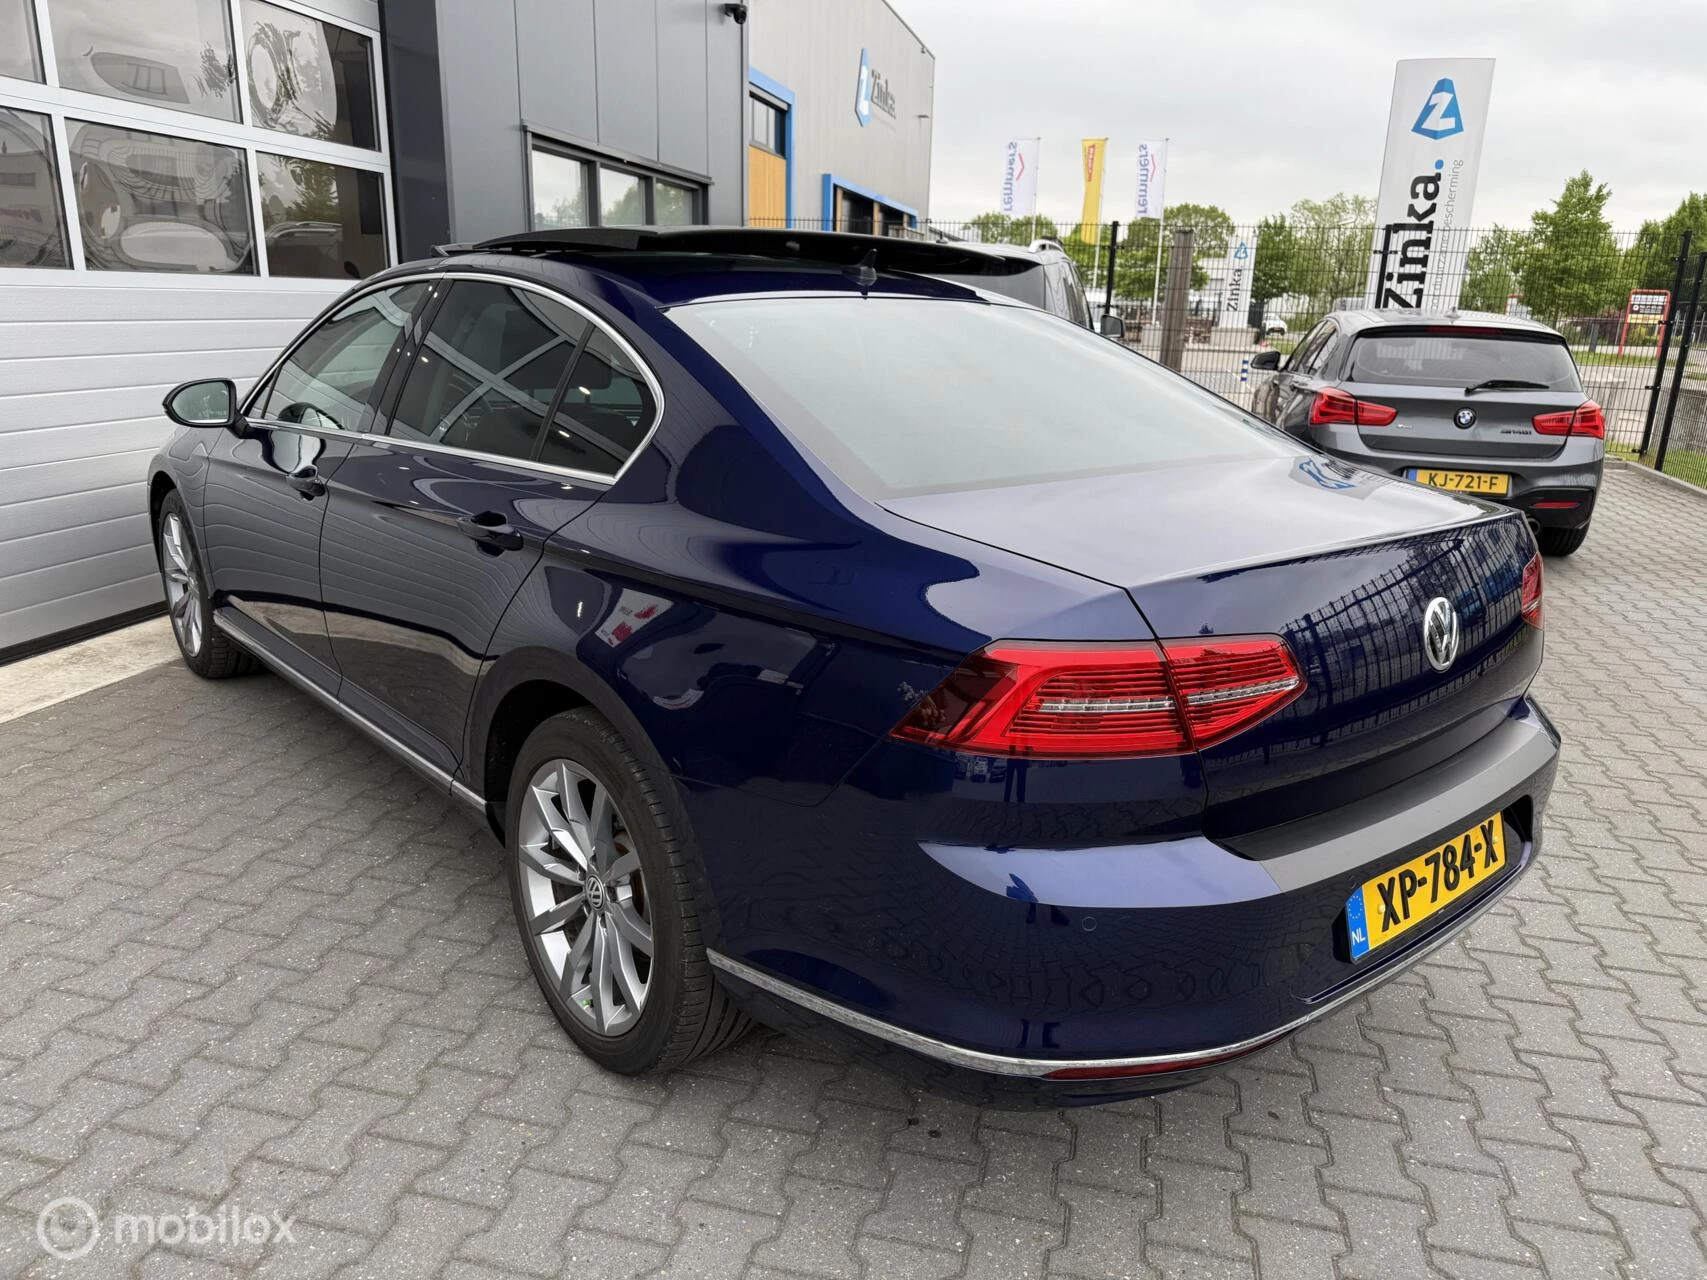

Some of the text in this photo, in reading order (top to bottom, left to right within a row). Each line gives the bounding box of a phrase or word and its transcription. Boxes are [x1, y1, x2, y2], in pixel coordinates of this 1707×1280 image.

[1428, 472, 1499, 490] KJ-721-F
[1376, 819, 1499, 933] XP-784-X
[1352, 928, 1366, 946] NL
